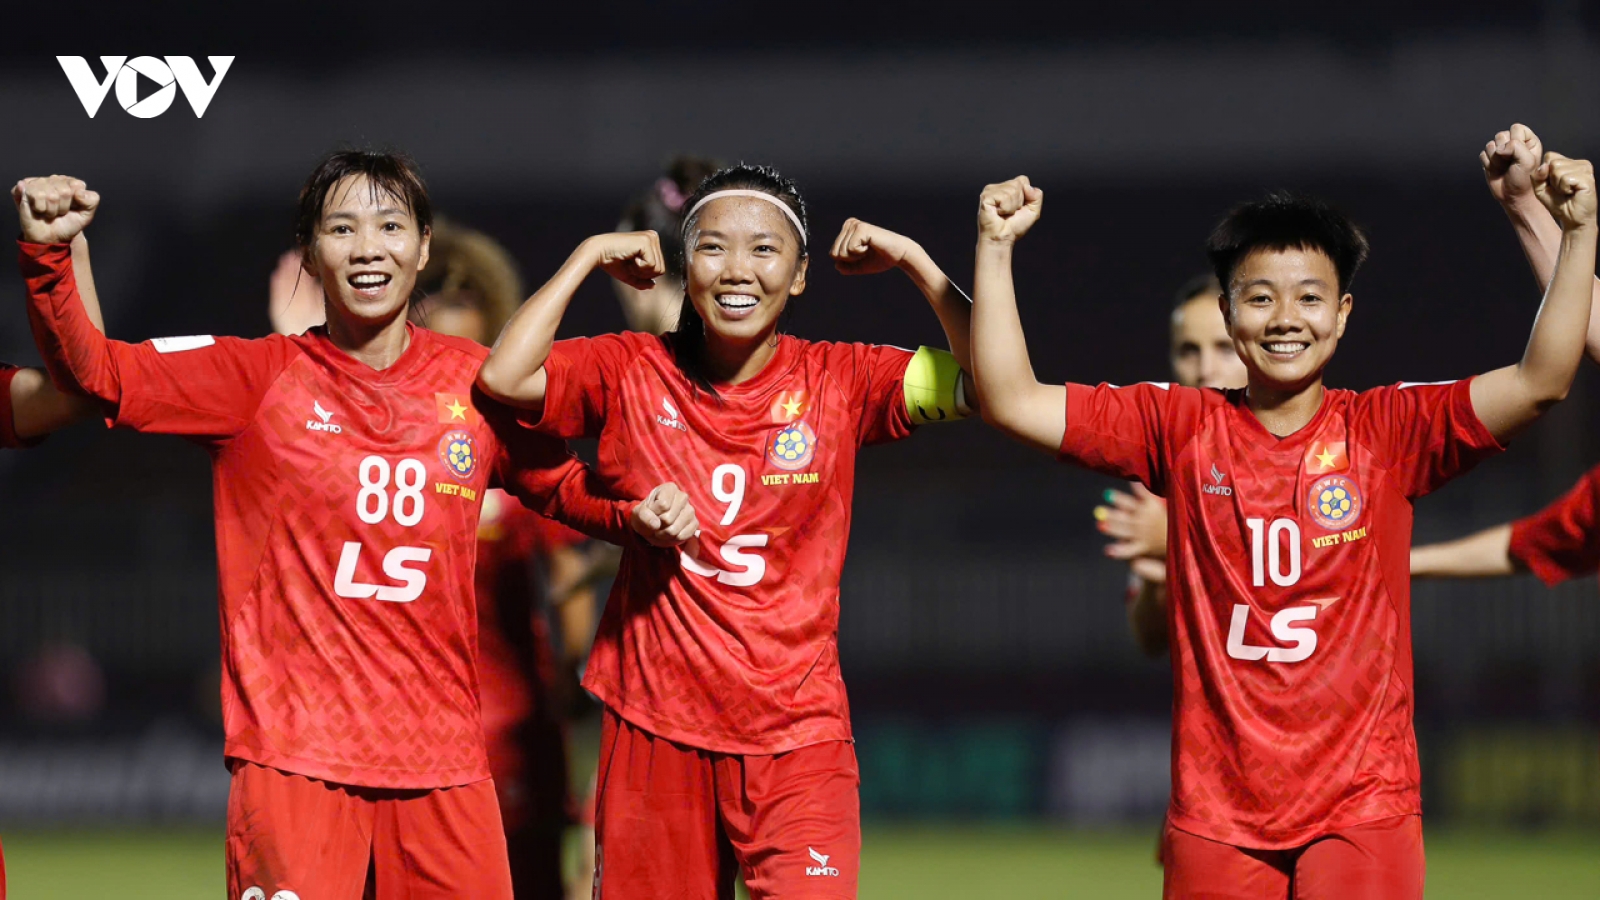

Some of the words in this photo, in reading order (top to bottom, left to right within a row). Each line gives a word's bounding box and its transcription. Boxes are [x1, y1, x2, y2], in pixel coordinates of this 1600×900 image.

[306, 419, 342, 434] KAMITO
[656, 414, 687, 432] KAMITO
[761, 474, 790, 486] VIET
[792, 472, 819, 484] NAM
[1202, 483, 1232, 496] KAMITO
[356, 454, 427, 527] 88
[435, 482, 460, 496] VIET
[460, 486, 477, 501] NAM
[711, 463, 746, 526] 9
[1312, 533, 1341, 549] VIET
[1342, 526, 1367, 543] NAM
[1246, 517, 1302, 587] 10
[334, 541, 432, 603] LS
[1226, 603, 1318, 662] LS
[805, 866, 840, 877] KAMITO
